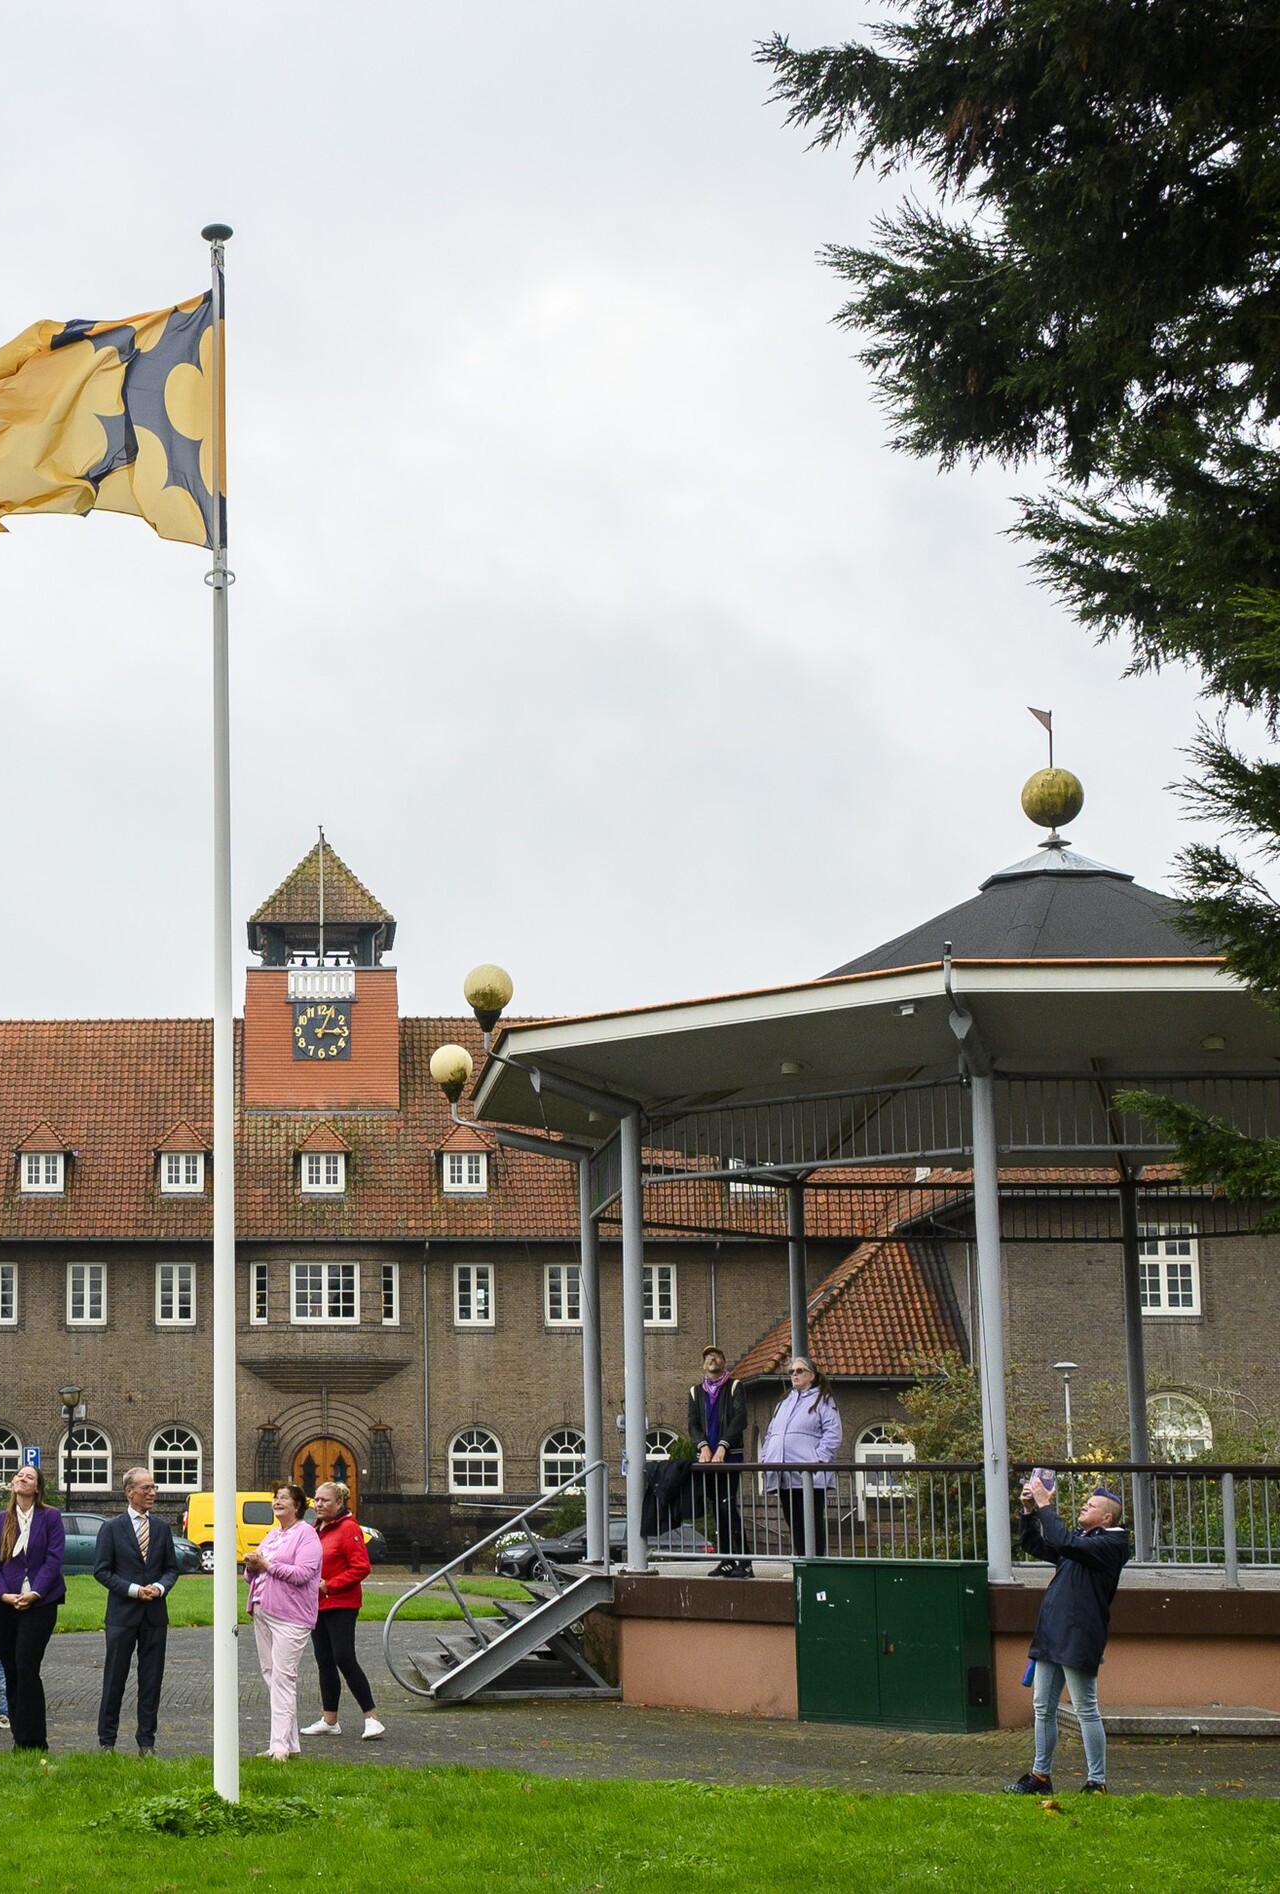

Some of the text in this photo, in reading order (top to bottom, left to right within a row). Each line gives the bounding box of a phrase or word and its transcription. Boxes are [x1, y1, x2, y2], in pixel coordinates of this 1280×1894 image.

[317, 1005, 327, 1015] 12
[298, 1015, 307, 1025] 10
[338, 1015, 345, 1025] 2
[294, 1026, 302, 1036] 9
[341, 1026, 349, 1037] 3
[298, 1037, 306, 1048] 8
[337, 1037, 346, 1048] 4
[308, 1045, 315, 1056] 7
[317, 1048, 325, 1059] 6
[328, 1045, 337, 1056] 5
[27, 1449, 37, 1462] P
